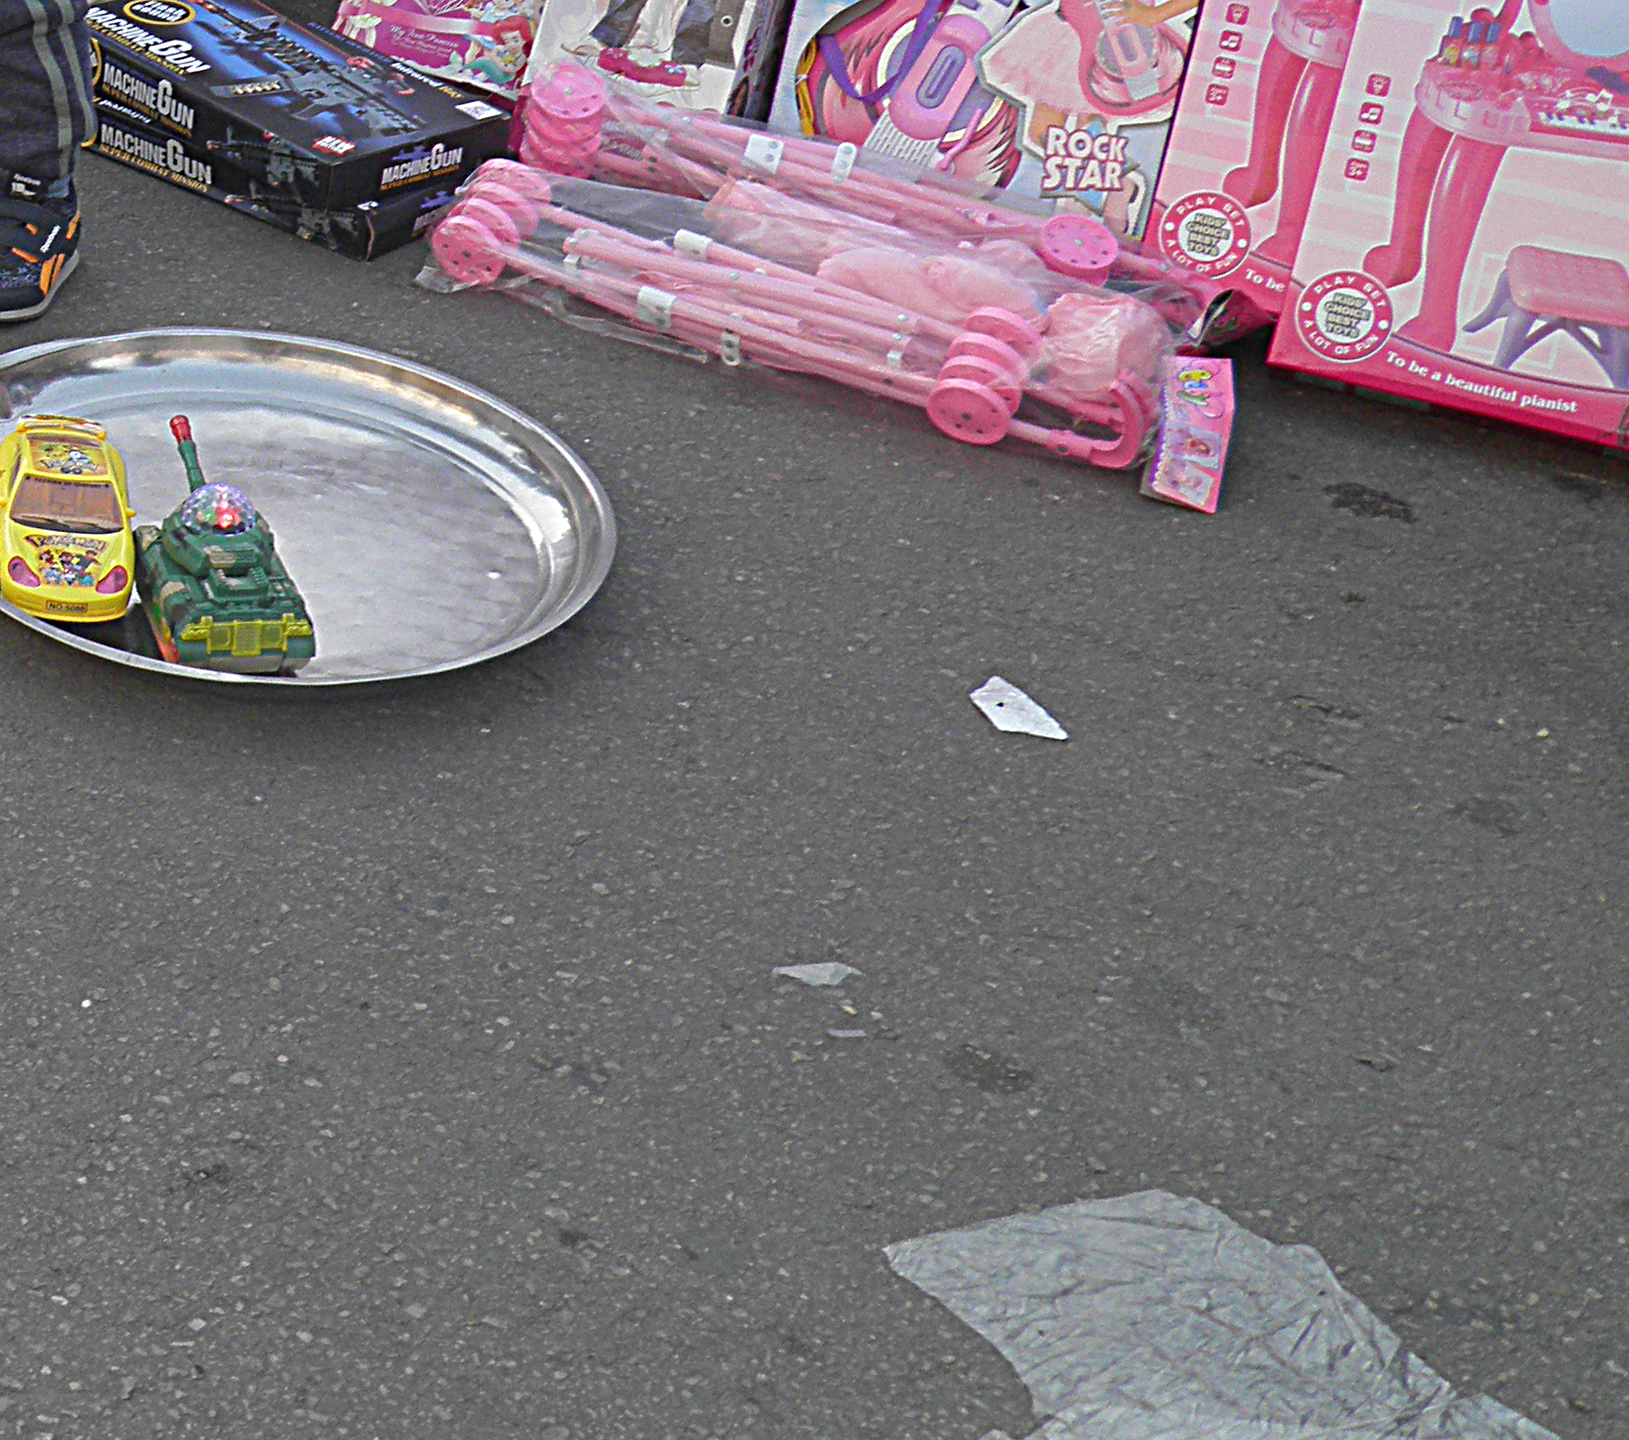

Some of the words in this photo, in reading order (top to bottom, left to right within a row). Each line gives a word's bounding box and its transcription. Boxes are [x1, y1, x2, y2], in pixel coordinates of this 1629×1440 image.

[1045, 125, 1129, 160] ROCK
[1041, 158, 1125, 193] STAR
[1176, 196, 1218, 215] PLAY
[1172, 250, 1193, 267] LOT
[1195, 264, 1212, 274] OF
[1245, 268, 1264, 285] To
[1265, 277, 1286, 293] be
[1313, 275, 1357, 295] PLAY
[1325, 301, 1371, 321] CHOICE
[1327, 312, 1360, 328] BEST
[1325, 323, 1361, 339] TOYS
[1309, 332, 1331, 350] LOT
[1334, 345, 1351, 355] OF
[1355, 335, 1379, 354] FUN
[1386, 350, 1408, 368] To
[1408, 360, 1429, 379] be
[1445, 373, 1518, 405] beautiful
[1520, 390, 1578, 414] pianist
